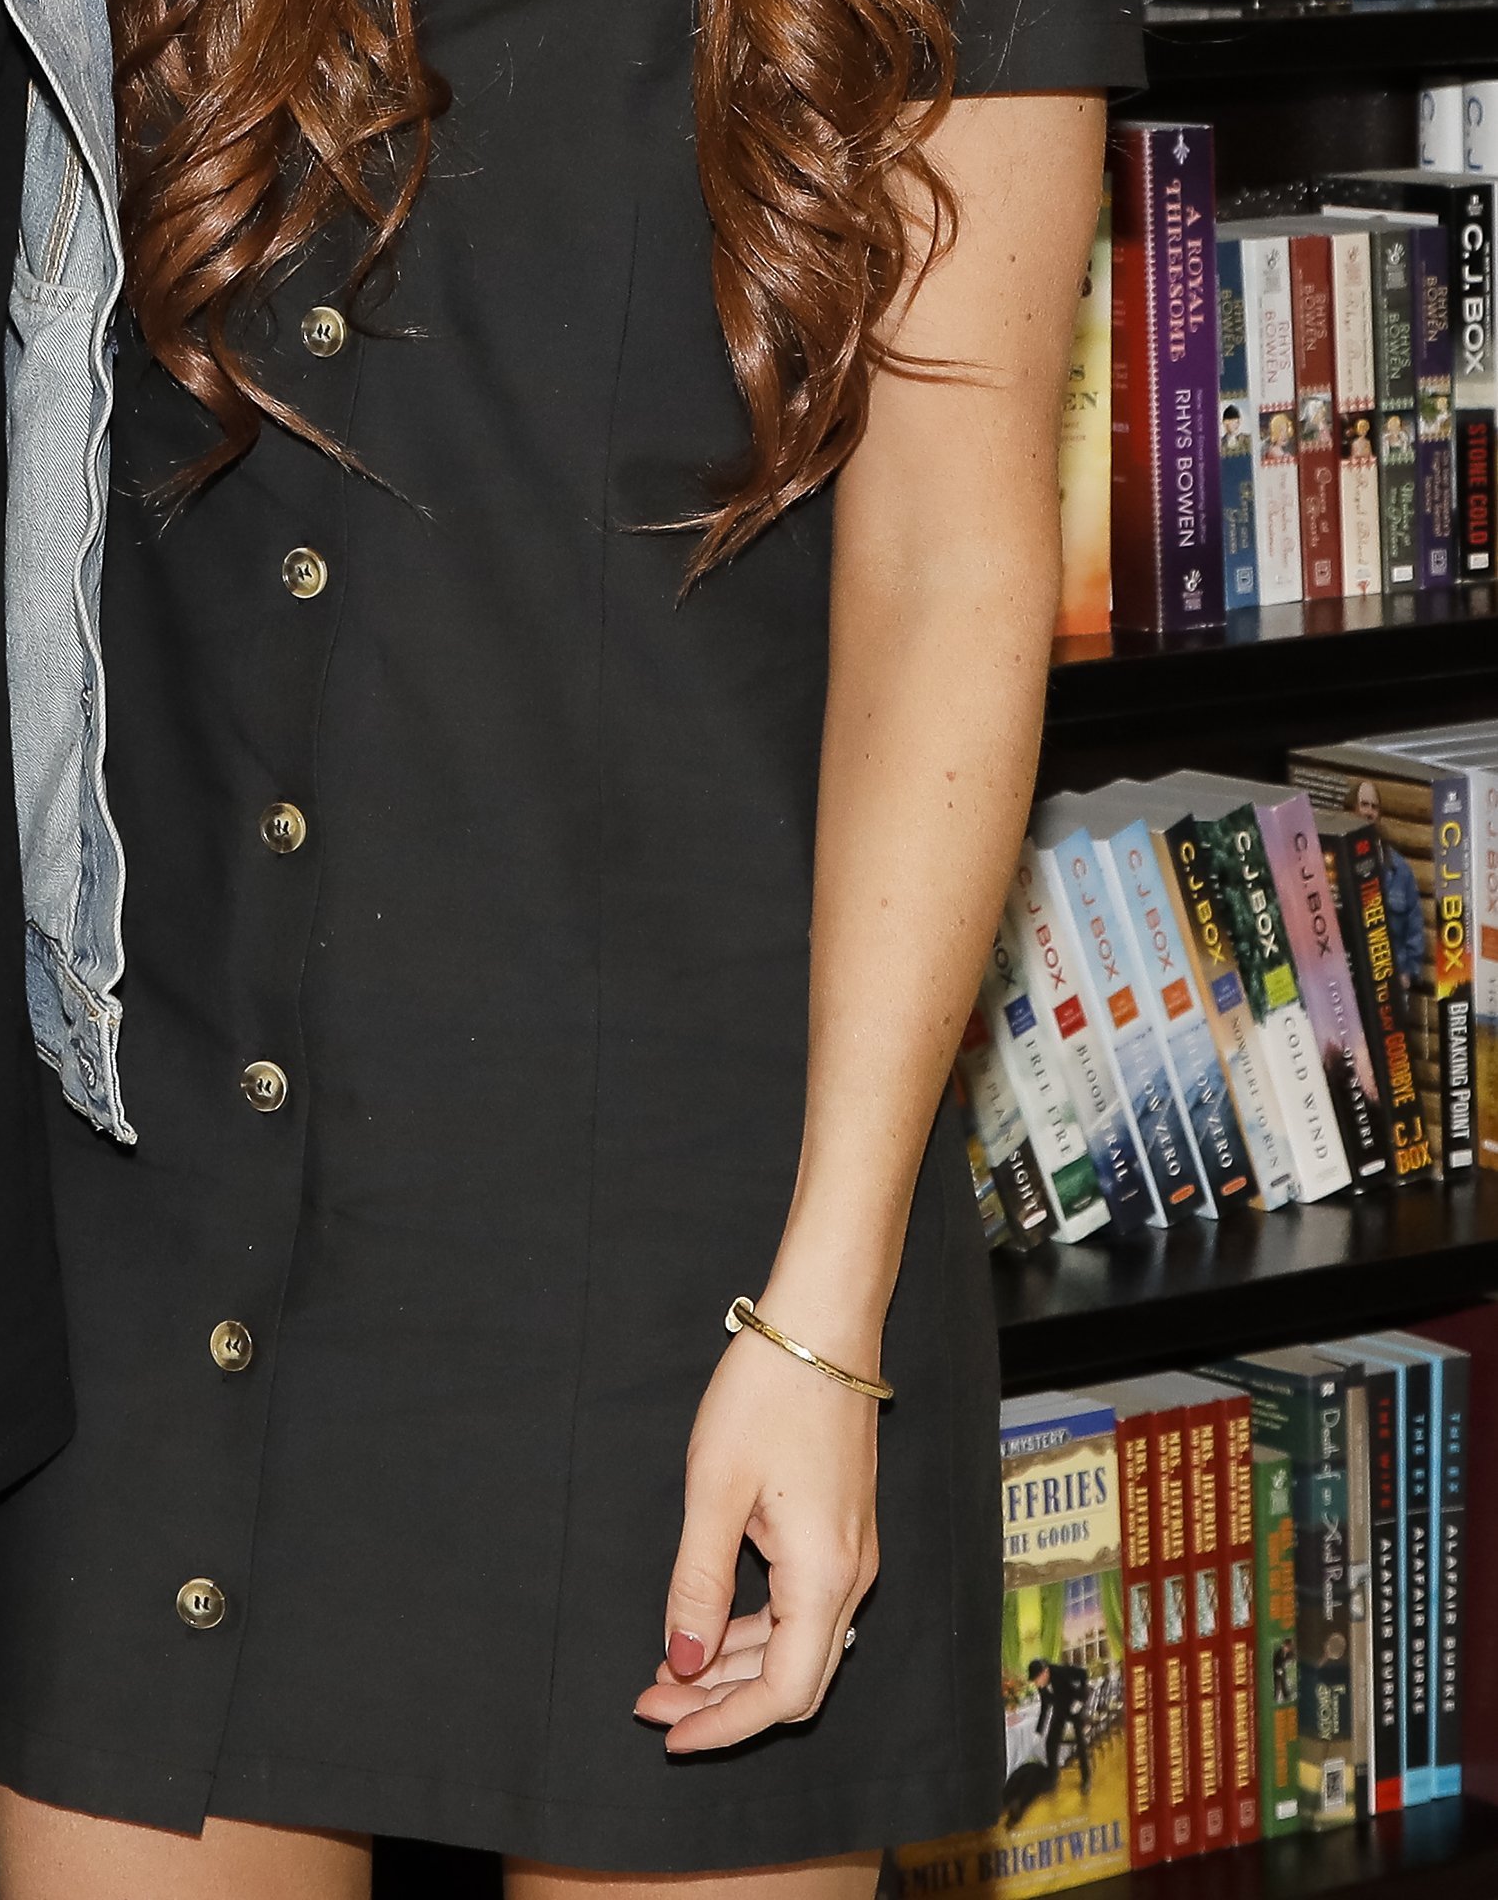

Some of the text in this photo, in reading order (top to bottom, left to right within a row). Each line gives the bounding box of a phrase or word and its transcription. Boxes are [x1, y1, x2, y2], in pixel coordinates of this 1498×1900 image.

[1164, 178, 1186, 364] THREESOME
[1186, 238, 1205, 335] ROYAL
[1463, 296, 1485, 377] BOX
[1175, 388, 1196, 549] RHYS BOWEN
[1196, 900, 1227, 967] BOX
[1250, 889, 1279, 959] BOX
[1307, 892, 1331, 957] BOX
[1439, 821, 1464, 973] C.J. BOX
[1035, 923, 1067, 991] BOX
[1365, 924, 1394, 983] WEEKS
[1284, 1015, 1329, 1161] COLD WIND
[1447, 1000, 1472, 1140] BREAKING POINT
[1350, 1077, 1374, 1150] NATURE
[1009, 1428, 1069, 1454] MYSTERY
[1037, 1520, 1091, 1551] GOODS
[1379, 1536, 1396, 1728] ALAFAIR BURKE
[1411, 1525, 1427, 1716] ALAFAIR BURKE
[1442, 1524, 1458, 1714] ALAFAIR BURKE
[979, 1819, 1124, 1879] BRIGHTWELL
